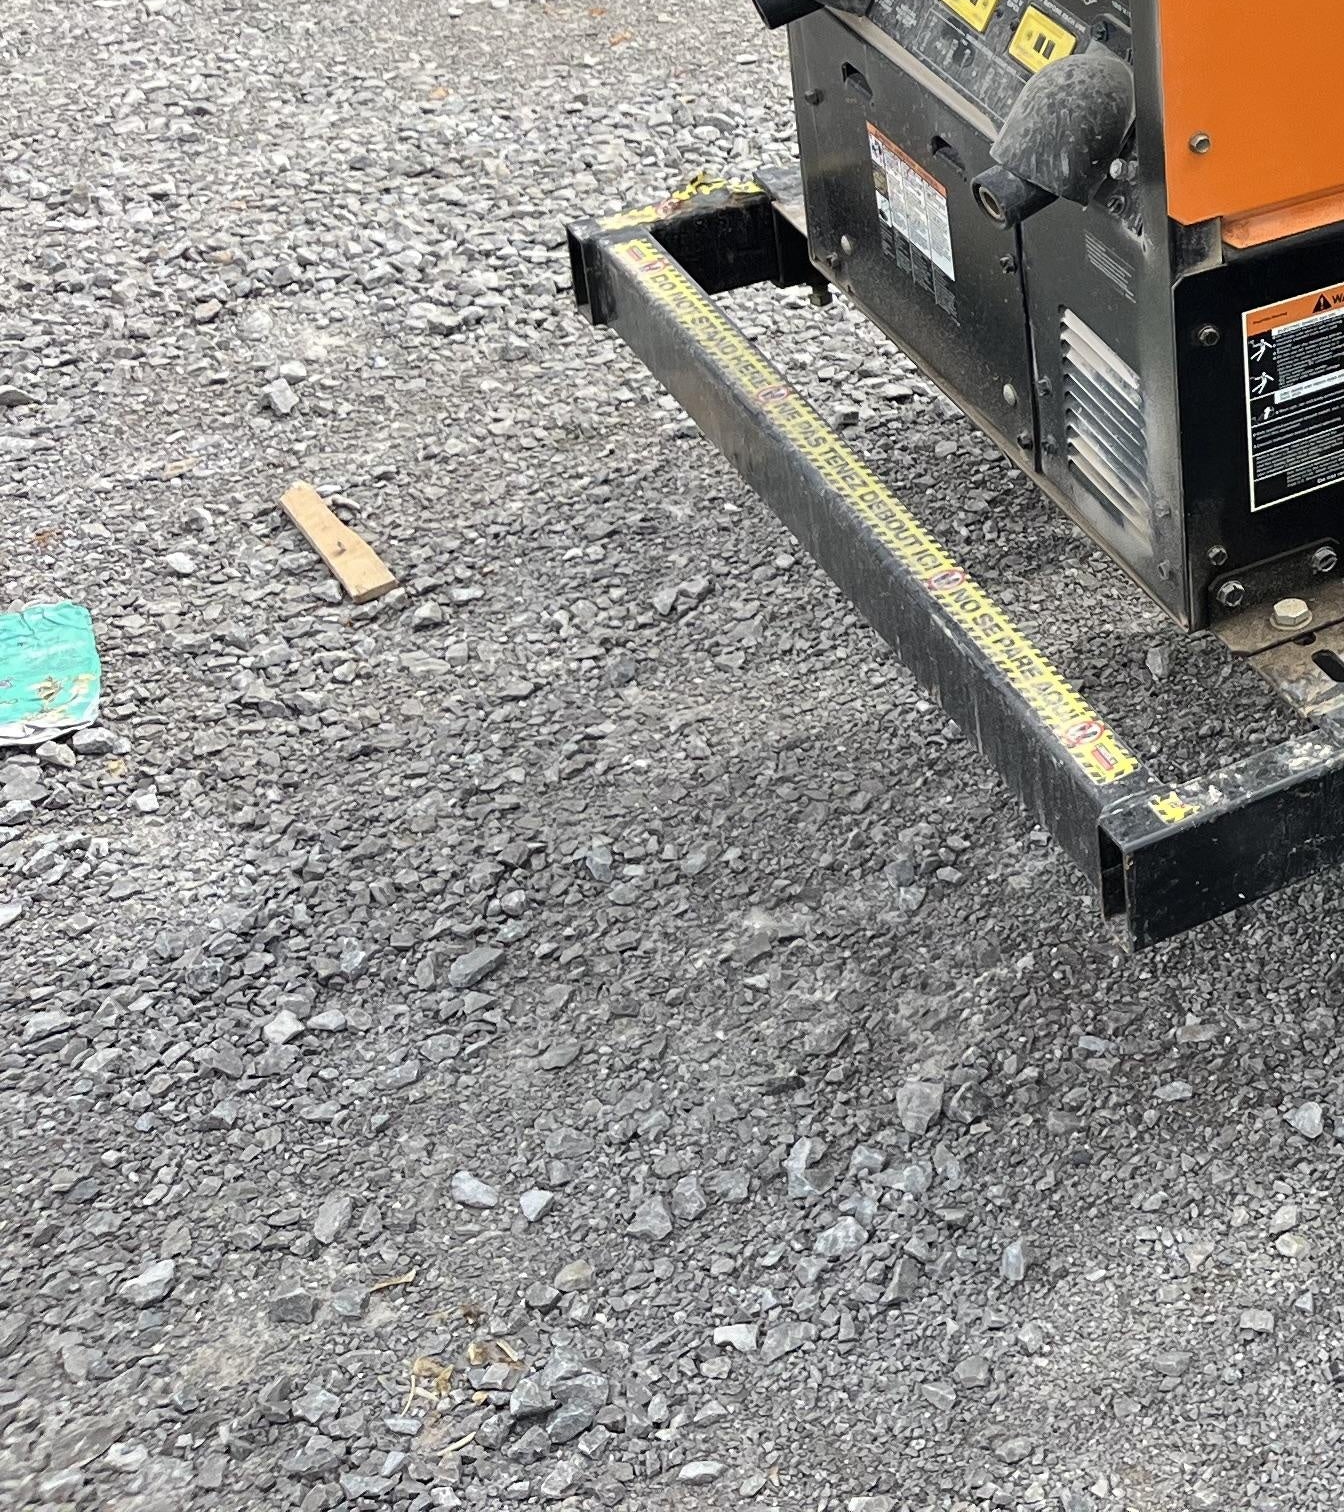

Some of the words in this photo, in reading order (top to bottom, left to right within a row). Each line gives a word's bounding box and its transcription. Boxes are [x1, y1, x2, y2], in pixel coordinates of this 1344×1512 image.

[650, 273, 676, 295] DO
[672, 294, 700, 321] NOT
[774, 401, 797, 421] NE
[797, 420, 827, 448] PAS
[818, 446, 870, 489] TENEZ
[858, 489, 923, 552] DEBOUT
[910, 549, 943, 571] ICI
[948, 588, 982, 613] NO
[972, 611, 1004, 637] SE
[993, 637, 1044, 684] PARE
